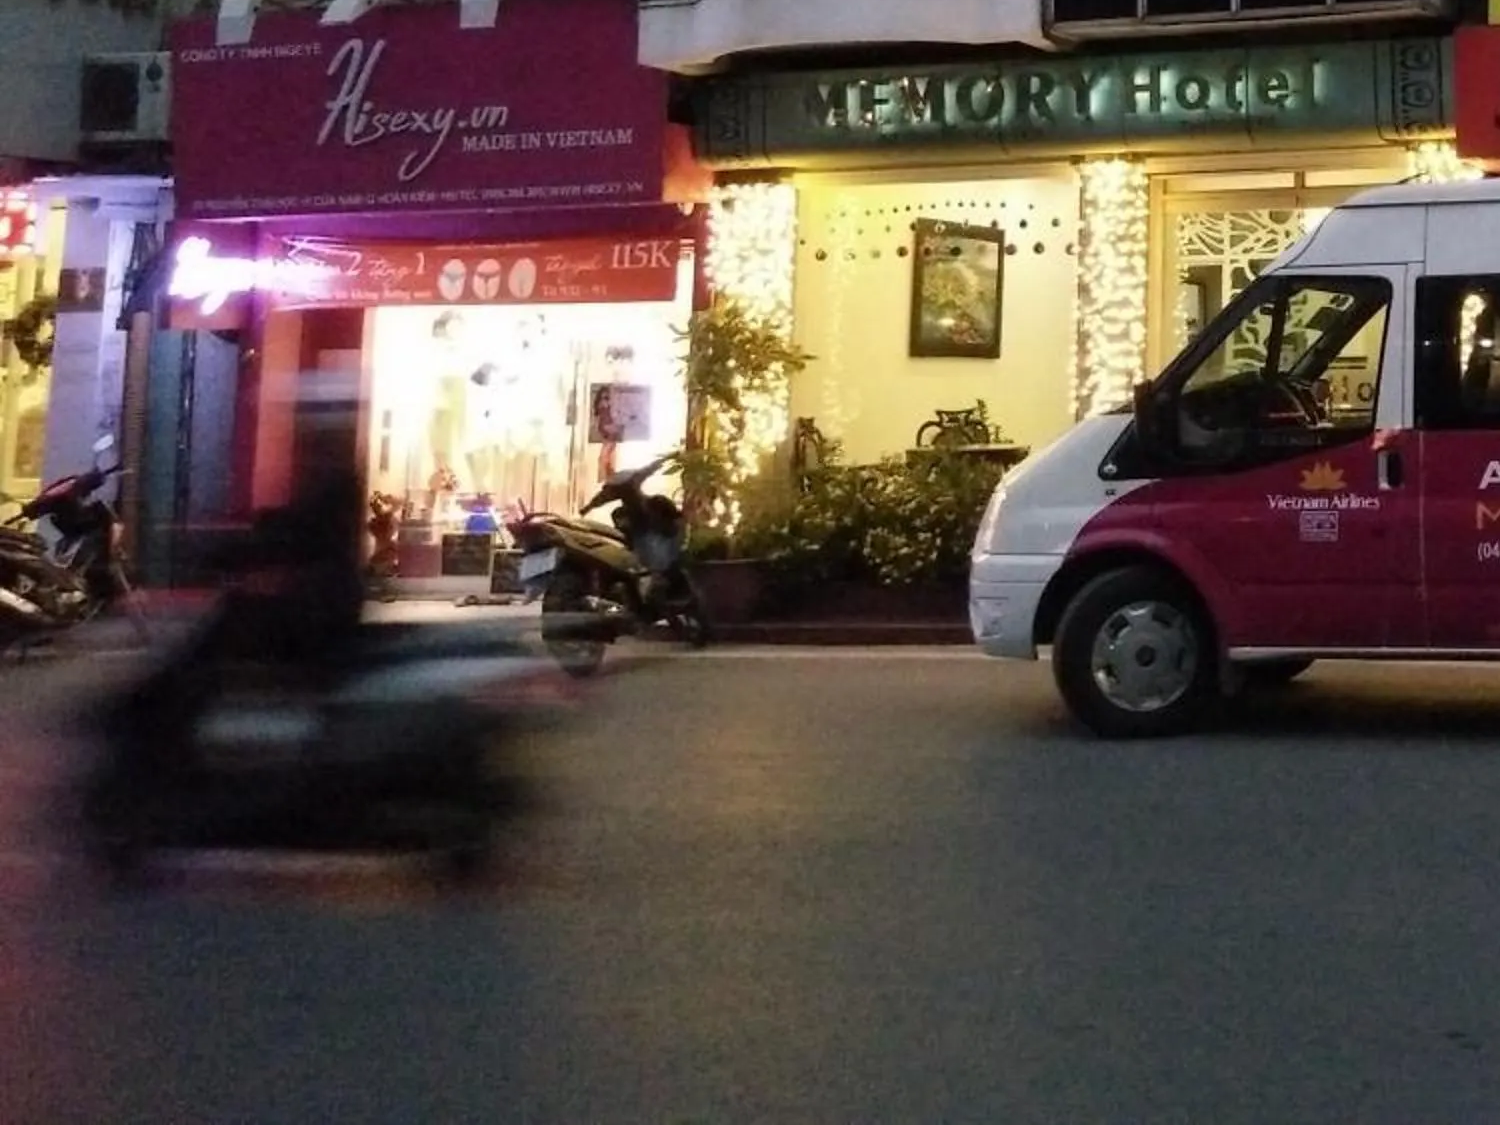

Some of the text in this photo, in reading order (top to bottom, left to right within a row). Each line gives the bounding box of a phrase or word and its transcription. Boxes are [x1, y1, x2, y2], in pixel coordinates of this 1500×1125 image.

[806, 69, 1108, 130] MEMORY
[463, 128, 634, 152] MADE IN VIETNAM
[609, 238, 674, 270] 115K
[1266, 493, 1381, 510] Vietnam Airlines
